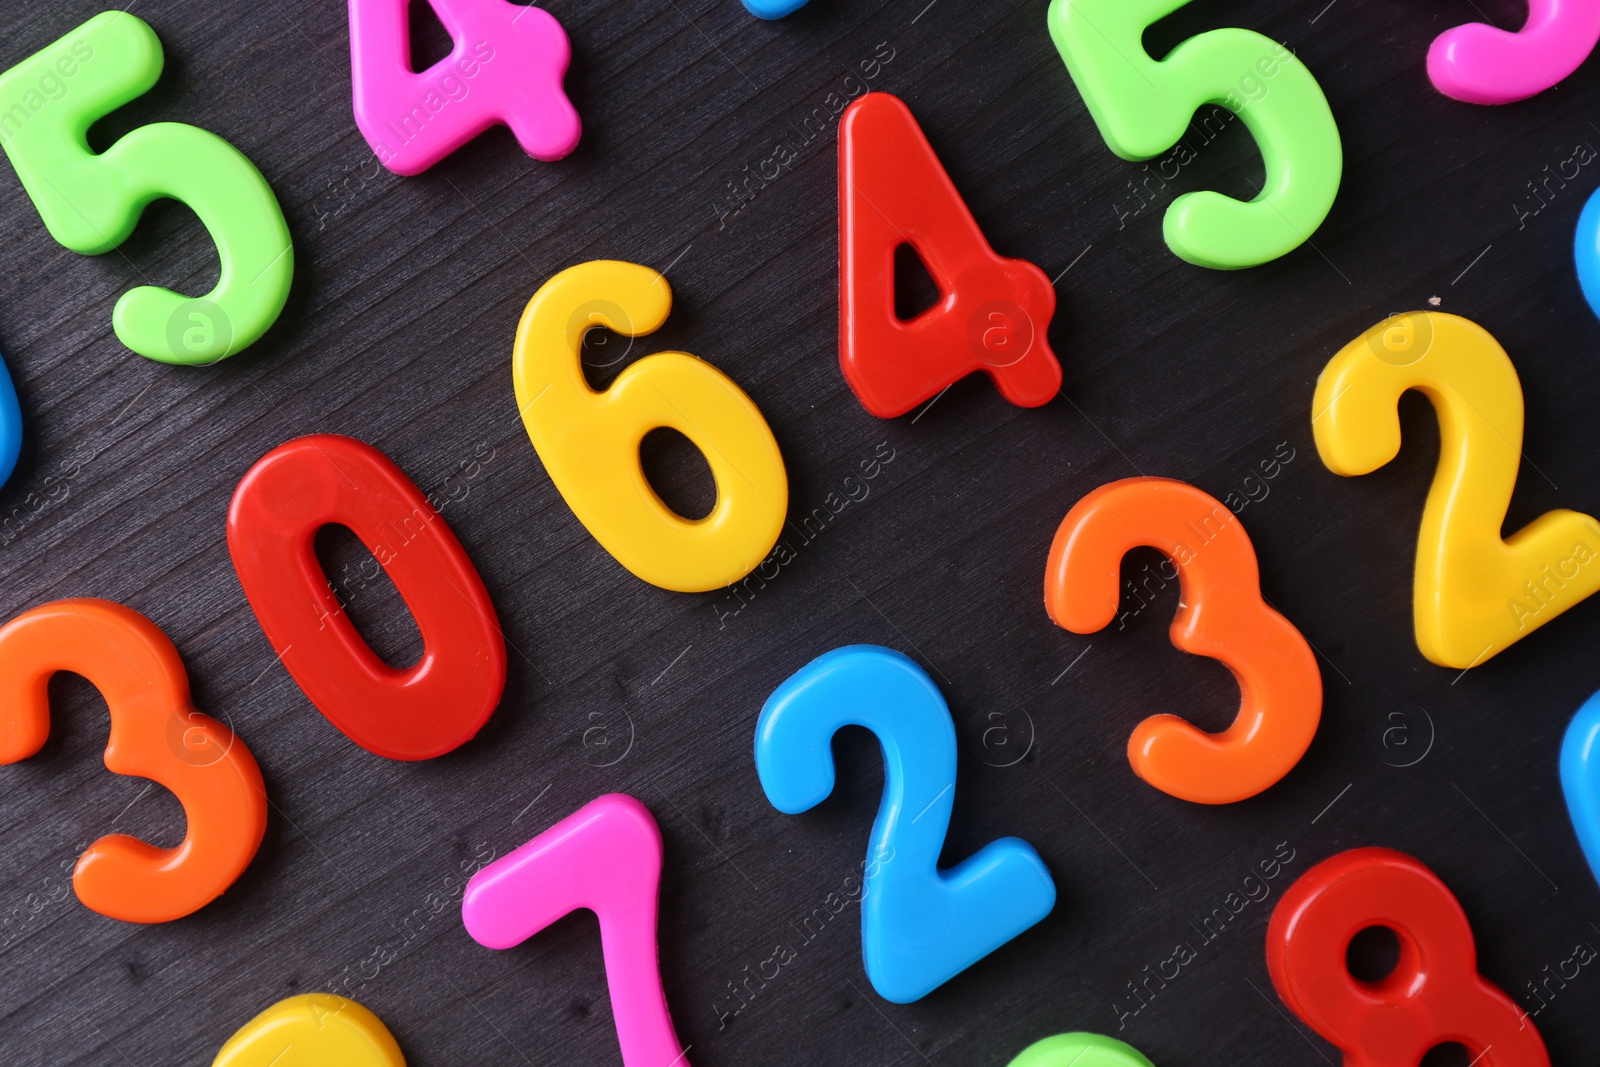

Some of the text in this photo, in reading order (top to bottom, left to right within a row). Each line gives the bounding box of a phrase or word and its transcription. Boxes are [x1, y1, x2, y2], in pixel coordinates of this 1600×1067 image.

[0, 10, 294, 366] 5
[837, 91, 1062, 419] 4
[1048, 0, 1343, 271] 5
[512, 259, 788, 593] 6
[1311, 311, 1600, 669] 2
[0, 598, 267, 924] 3
[226, 433, 506, 761] 0
[1044, 476, 1323, 805] 3
[462, 792, 690, 1067] 7
[753, 644, 1056, 1004] 2
[1265, 847, 1551, 1067] 8
